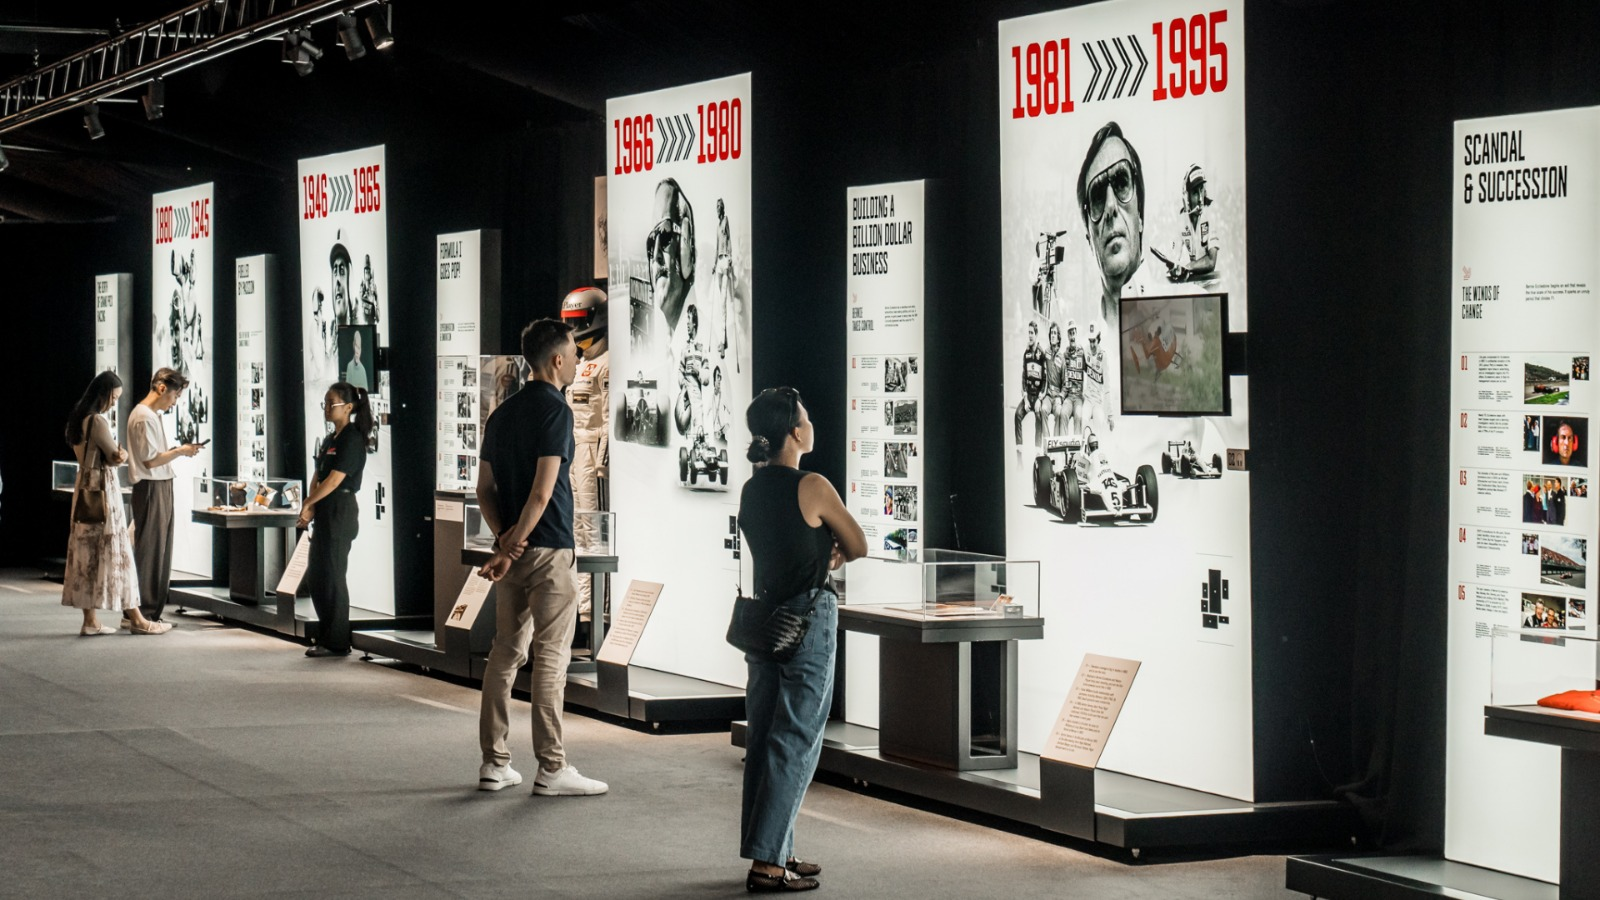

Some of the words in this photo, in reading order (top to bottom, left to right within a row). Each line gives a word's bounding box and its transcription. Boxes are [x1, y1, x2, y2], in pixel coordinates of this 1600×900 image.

[1012, 38, 1074, 119] 1981
[1152, 9, 1228, 101] 1995
[614, 113, 654, 175] 1966
[697, 97, 742, 164] 1980
[1464, 130, 1526, 166] SCANDAL
[303, 173, 328, 220] 1946
[353, 164, 381, 214] 1965
[1464, 173, 1474, 204] &
[1478, 165, 1568, 203] SUCCESSION
[853, 195, 888, 220] BUILDING
[889, 195, 895, 217] A
[156, 205, 173, 245] 1880
[191, 198, 209, 240] 1945
[853, 223, 883, 248] BILLION
[884, 221, 912, 246] DOLLAR
[440, 242, 459, 259] FORMULA
[440, 262, 450, 280] GOES
[853, 251, 888, 276] BUSINESS
[1462, 286, 1472, 301] THE
[1473, 286, 1492, 301] WINDS
[1493, 285, 1500, 300] OF
[1462, 304, 1483, 319] CHANGE
[1461, 355, 1468, 371] 01
[1460, 412, 1467, 428] 02
[1459, 470, 1467, 486] 03
[1111, 492, 1121, 506] 5
[1459, 527, 1466, 543] 04
[1458, 584, 1466, 600] 05
